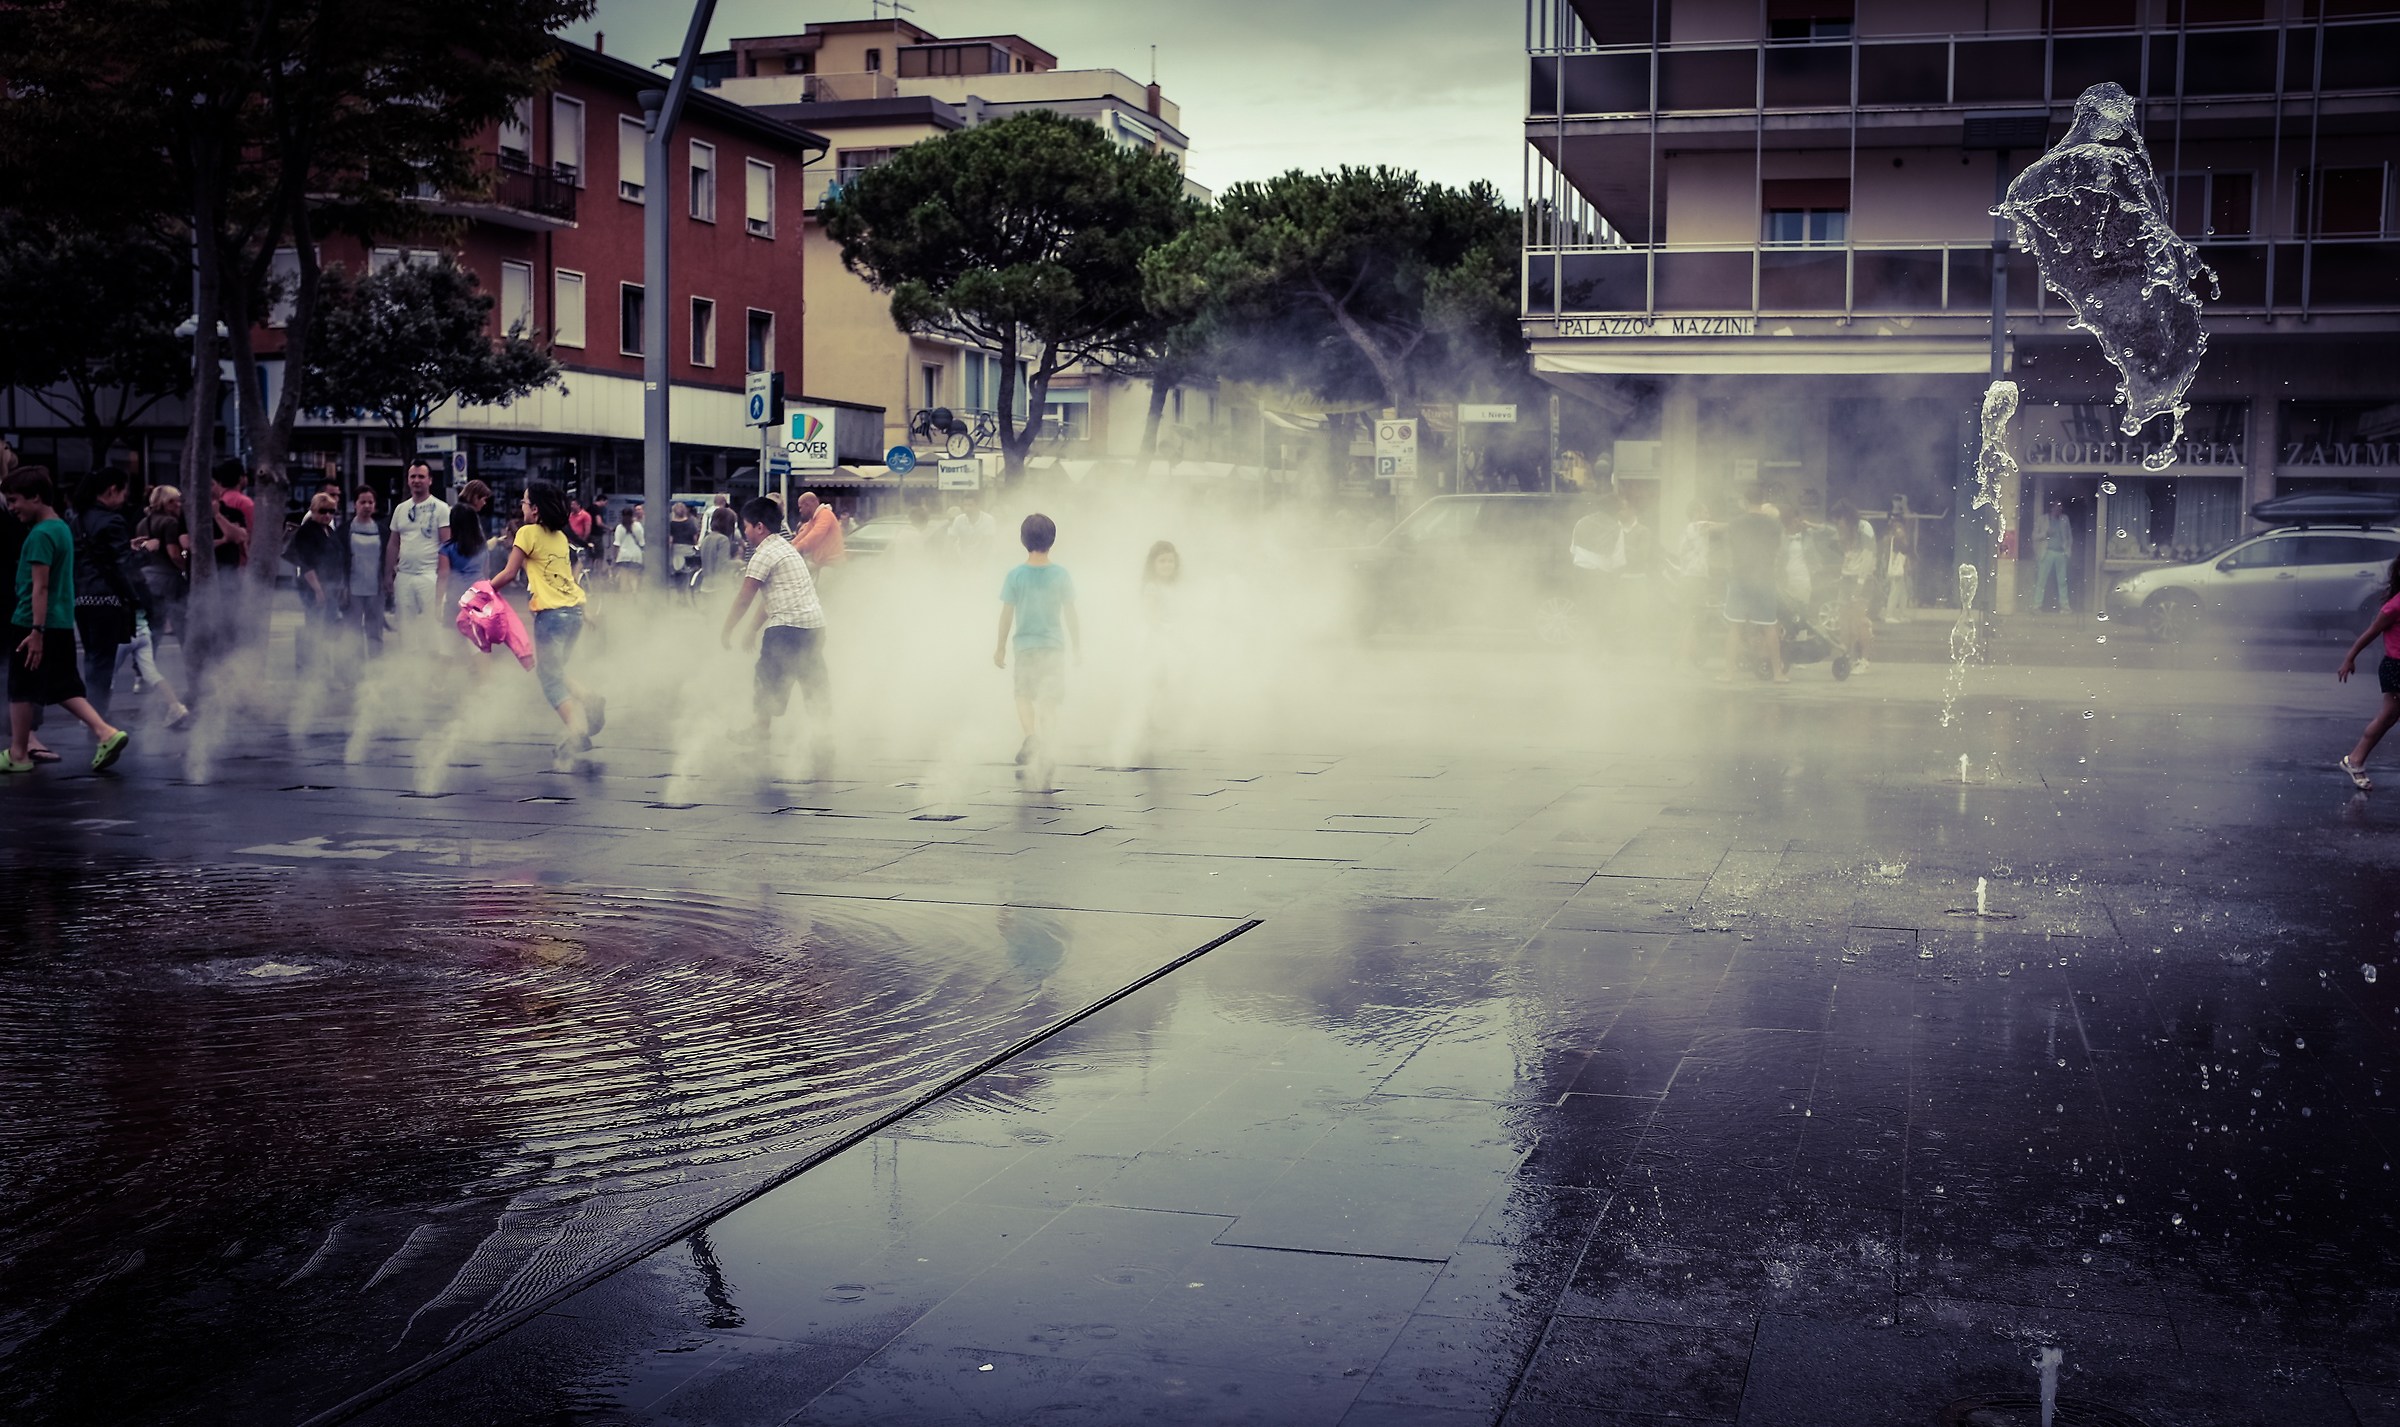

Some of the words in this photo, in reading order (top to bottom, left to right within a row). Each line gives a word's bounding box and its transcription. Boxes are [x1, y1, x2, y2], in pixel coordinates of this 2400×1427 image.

[786, 441, 828, 454] COVER
[2024, 442, 2243, 466] GIOIELLRIA
[2286, 443, 2400, 466] ZAMM
